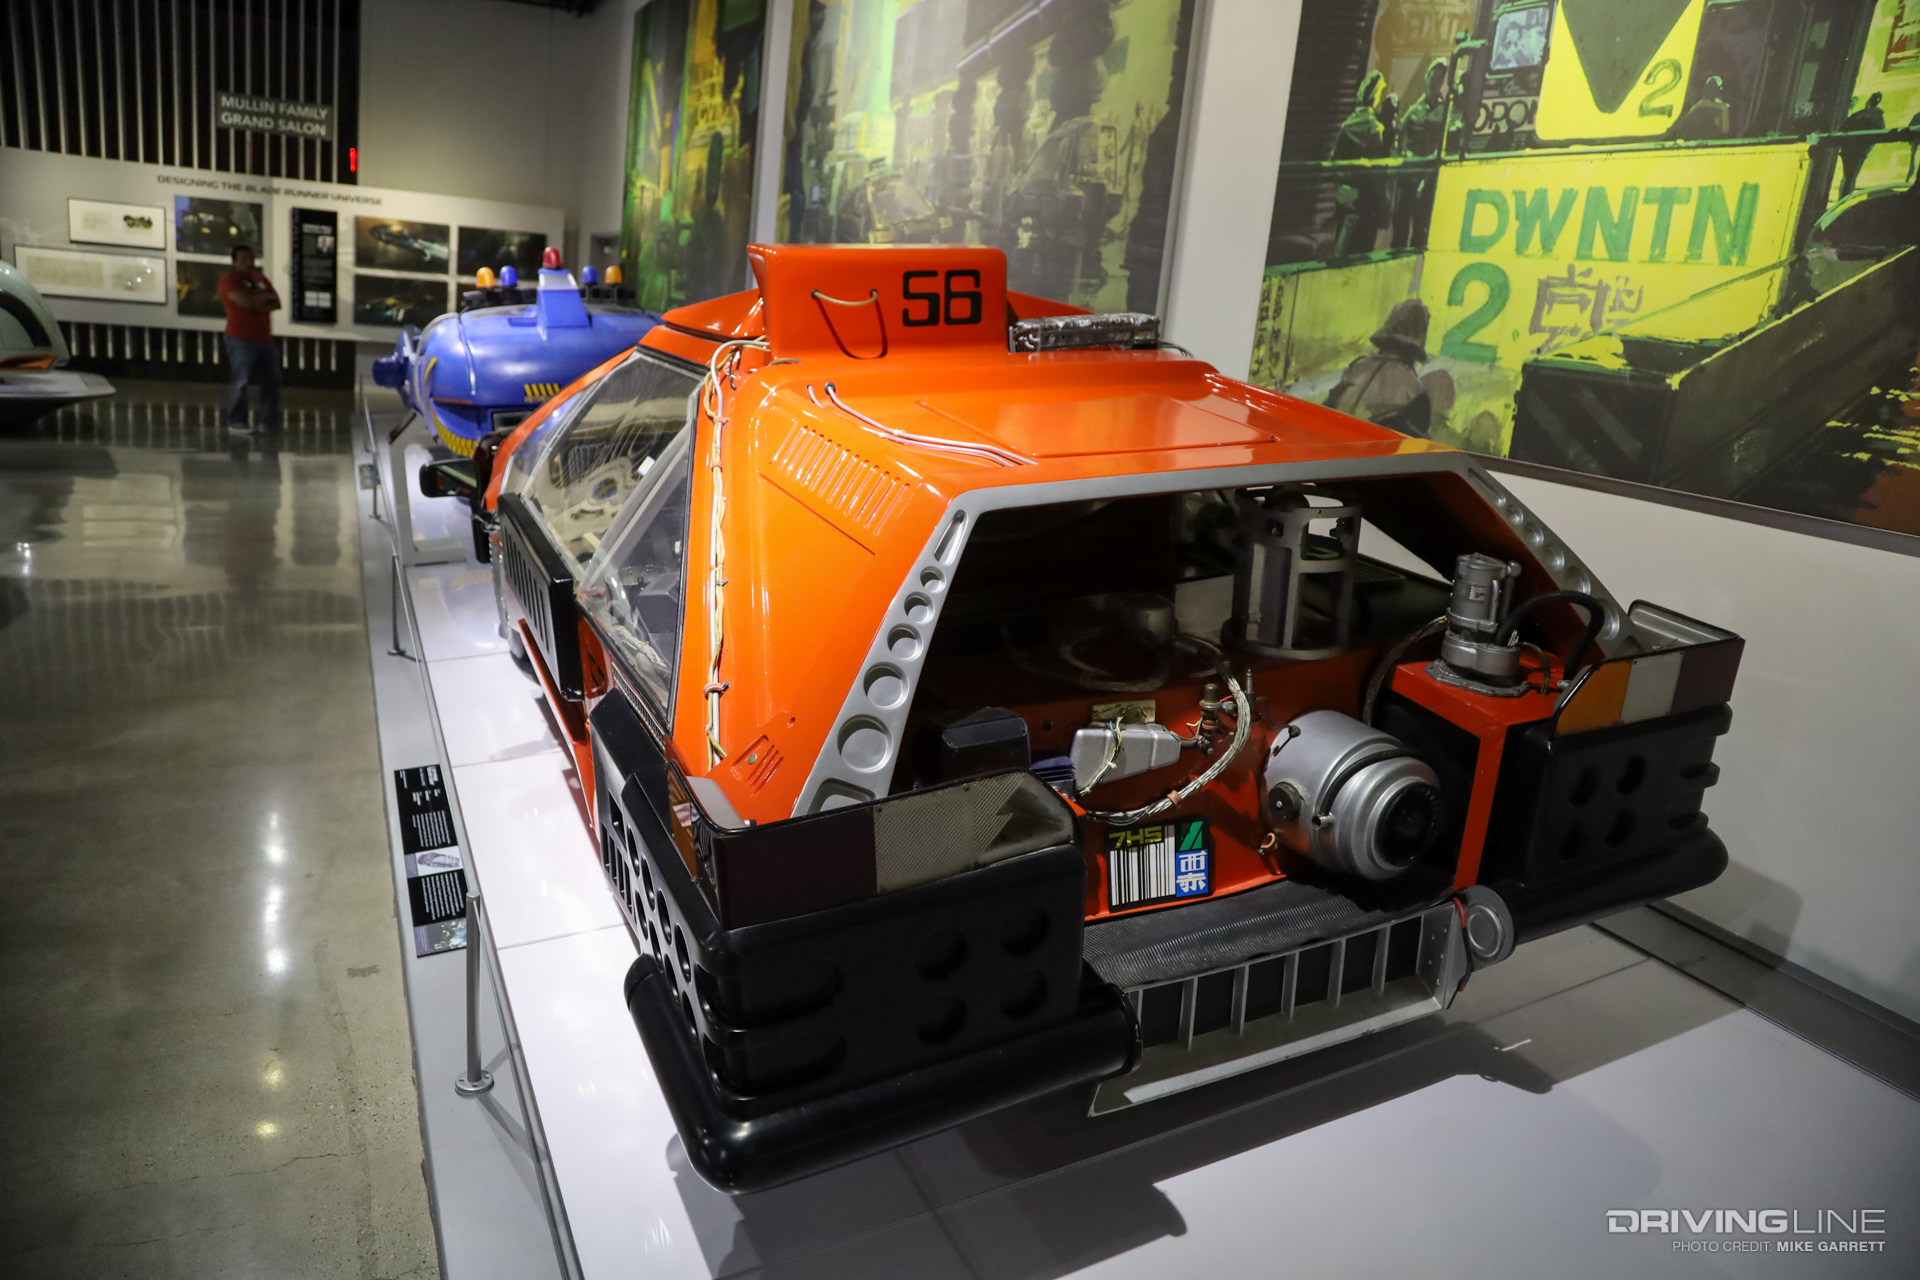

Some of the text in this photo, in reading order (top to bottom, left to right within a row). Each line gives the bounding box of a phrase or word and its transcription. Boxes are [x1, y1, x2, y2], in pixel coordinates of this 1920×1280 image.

[221, 95, 328, 120] MULLIN FAMILY
[1638, 58, 1682, 118] 2
[221, 111, 327, 137] GRAND SALON
[157, 174, 219, 190] DESIGNING
[221, 181, 243, 193] THE
[331, 192, 383, 206] UNIVERSE
[1459, 181, 1761, 267] DWNTN
[902, 269, 982, 327] 56
[1439, 261, 1511, 367] 2
